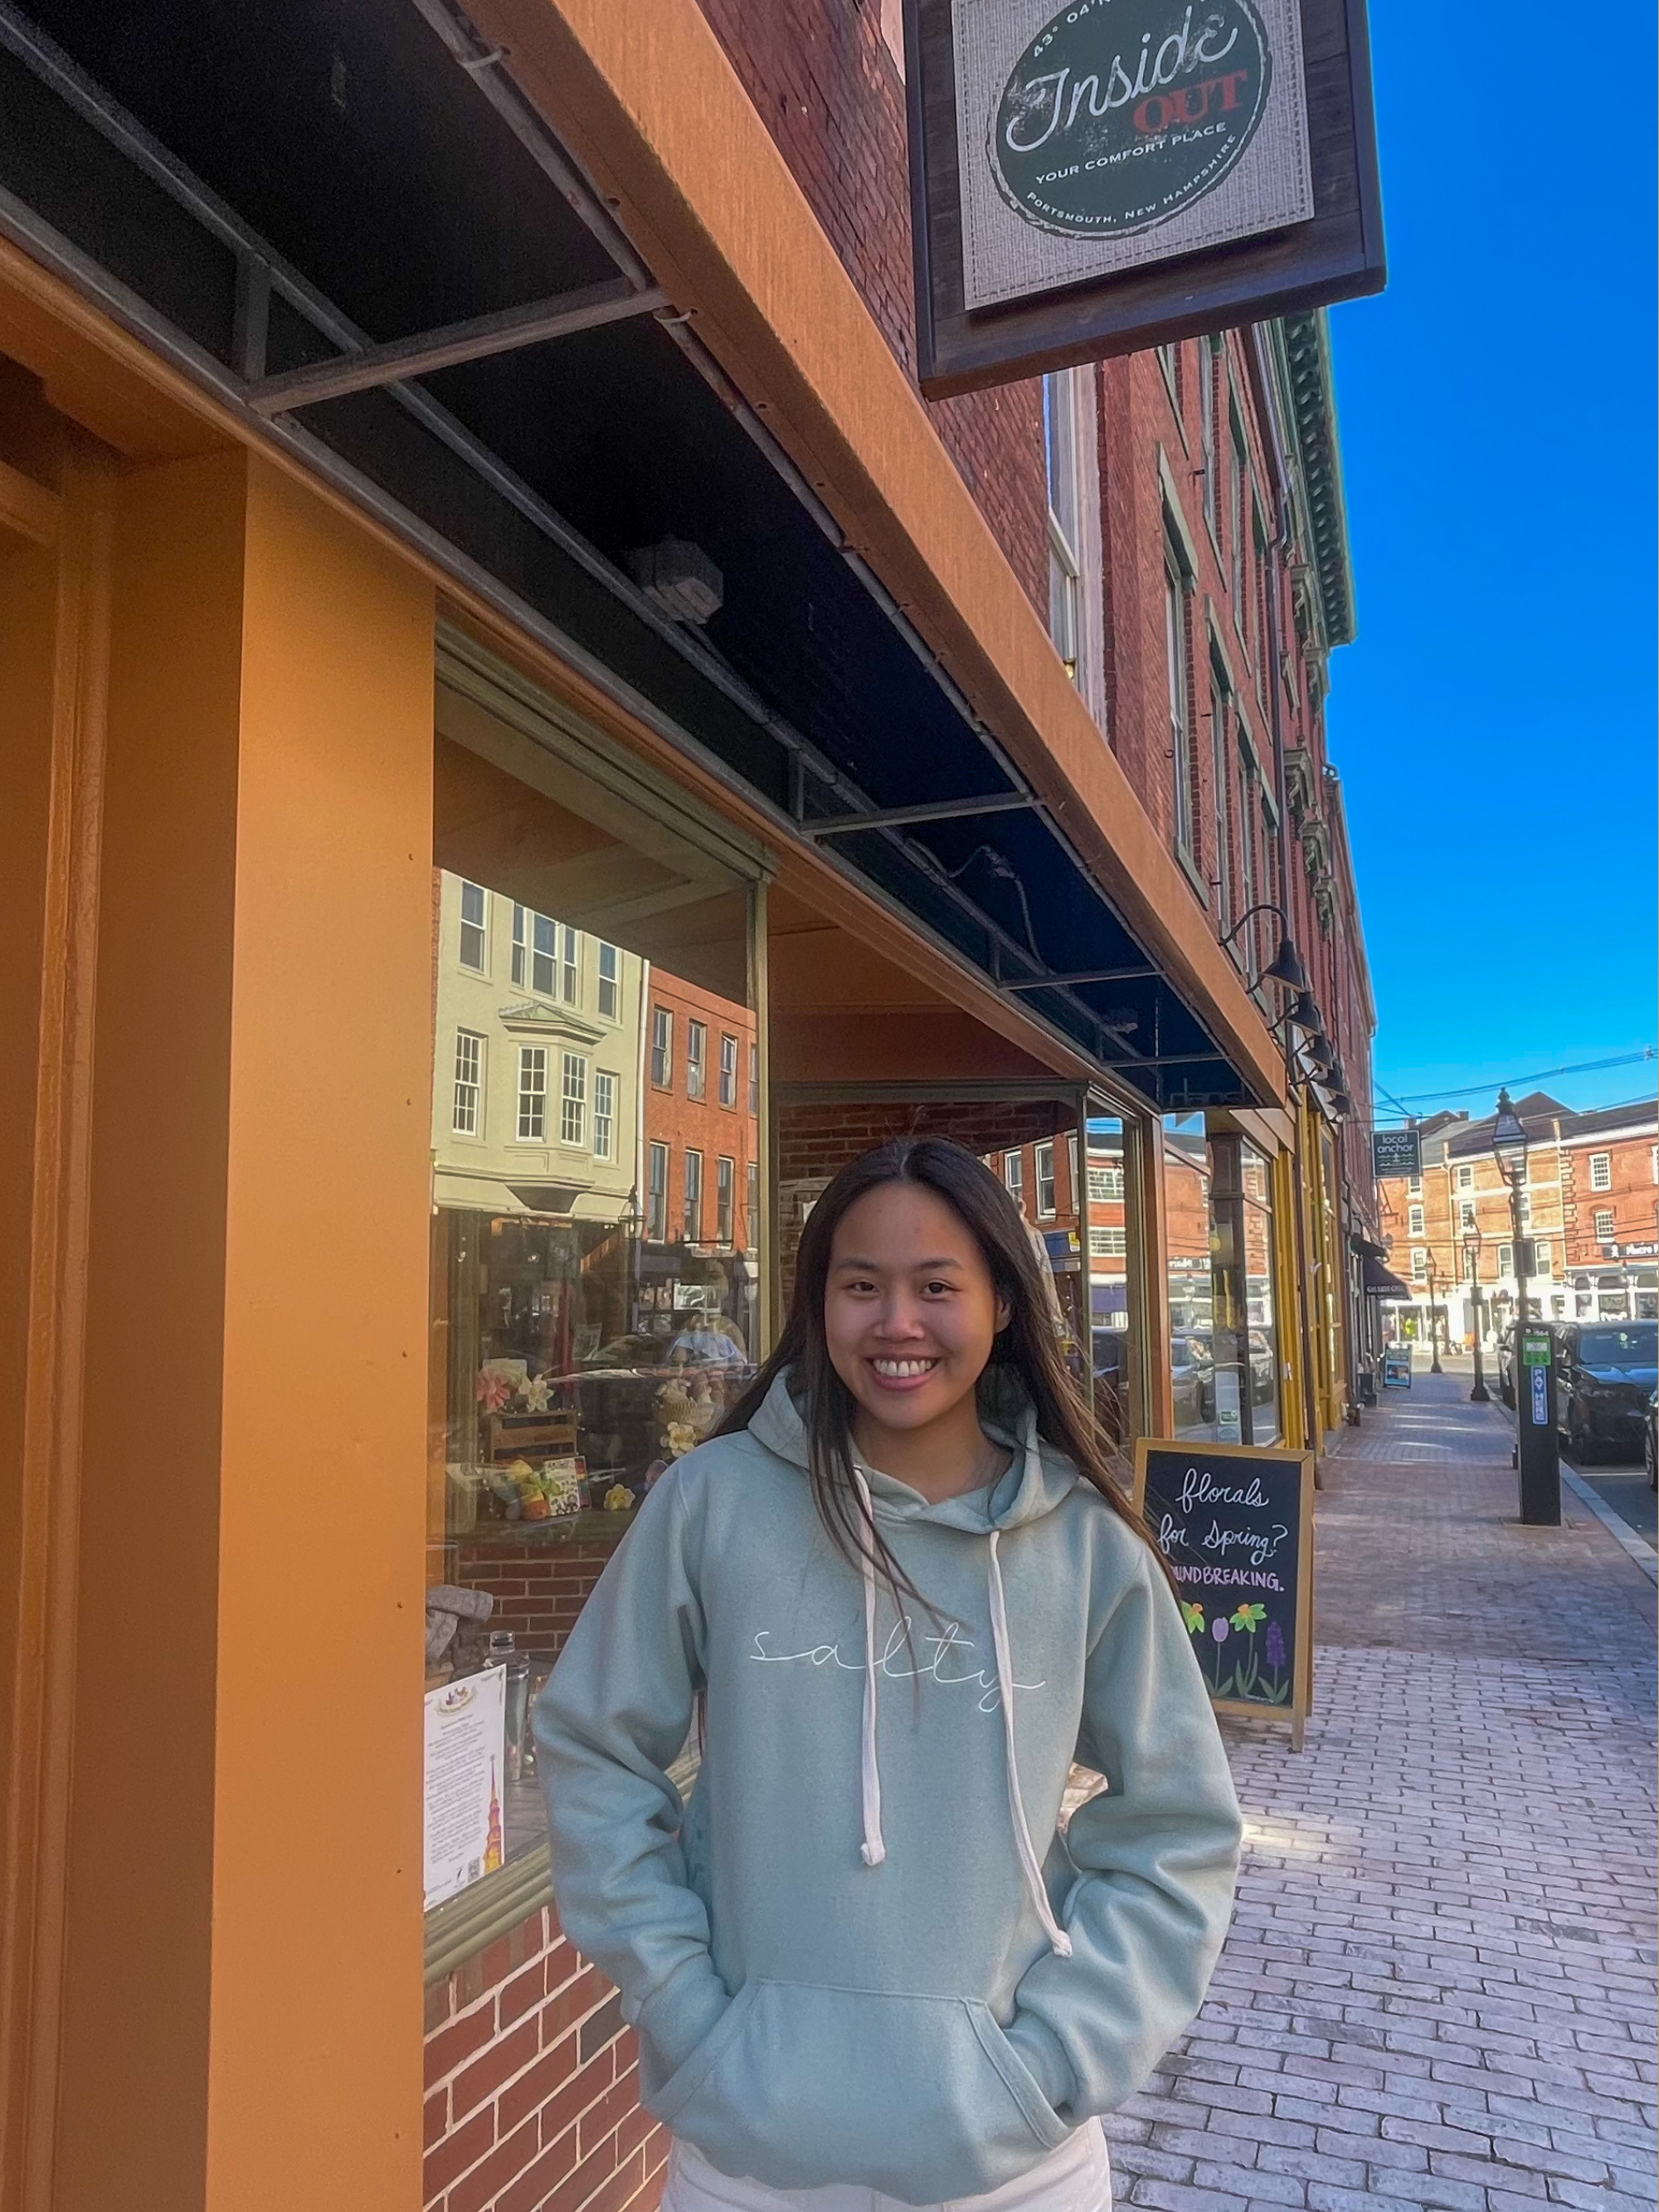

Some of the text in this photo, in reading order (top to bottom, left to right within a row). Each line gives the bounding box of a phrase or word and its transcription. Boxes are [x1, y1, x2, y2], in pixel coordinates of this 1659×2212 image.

[1005, 5, 1238, 152] Inside
[1132, 70, 1248, 133] OUT
[1035, 121, 1227, 184] YOUR COMFORT PLACE
[1026, 134, 1236, 224] PORTSMOUTH, NEW HAMPSHIRE
[1377, 1141, 1413, 1153] anchor
[1382, 1133, 1408, 1144] local
[1535, 1368, 1544, 1391] PAY
[1175, 1468, 1269, 1513] florals
[1157, 1513, 1190, 1554] for
